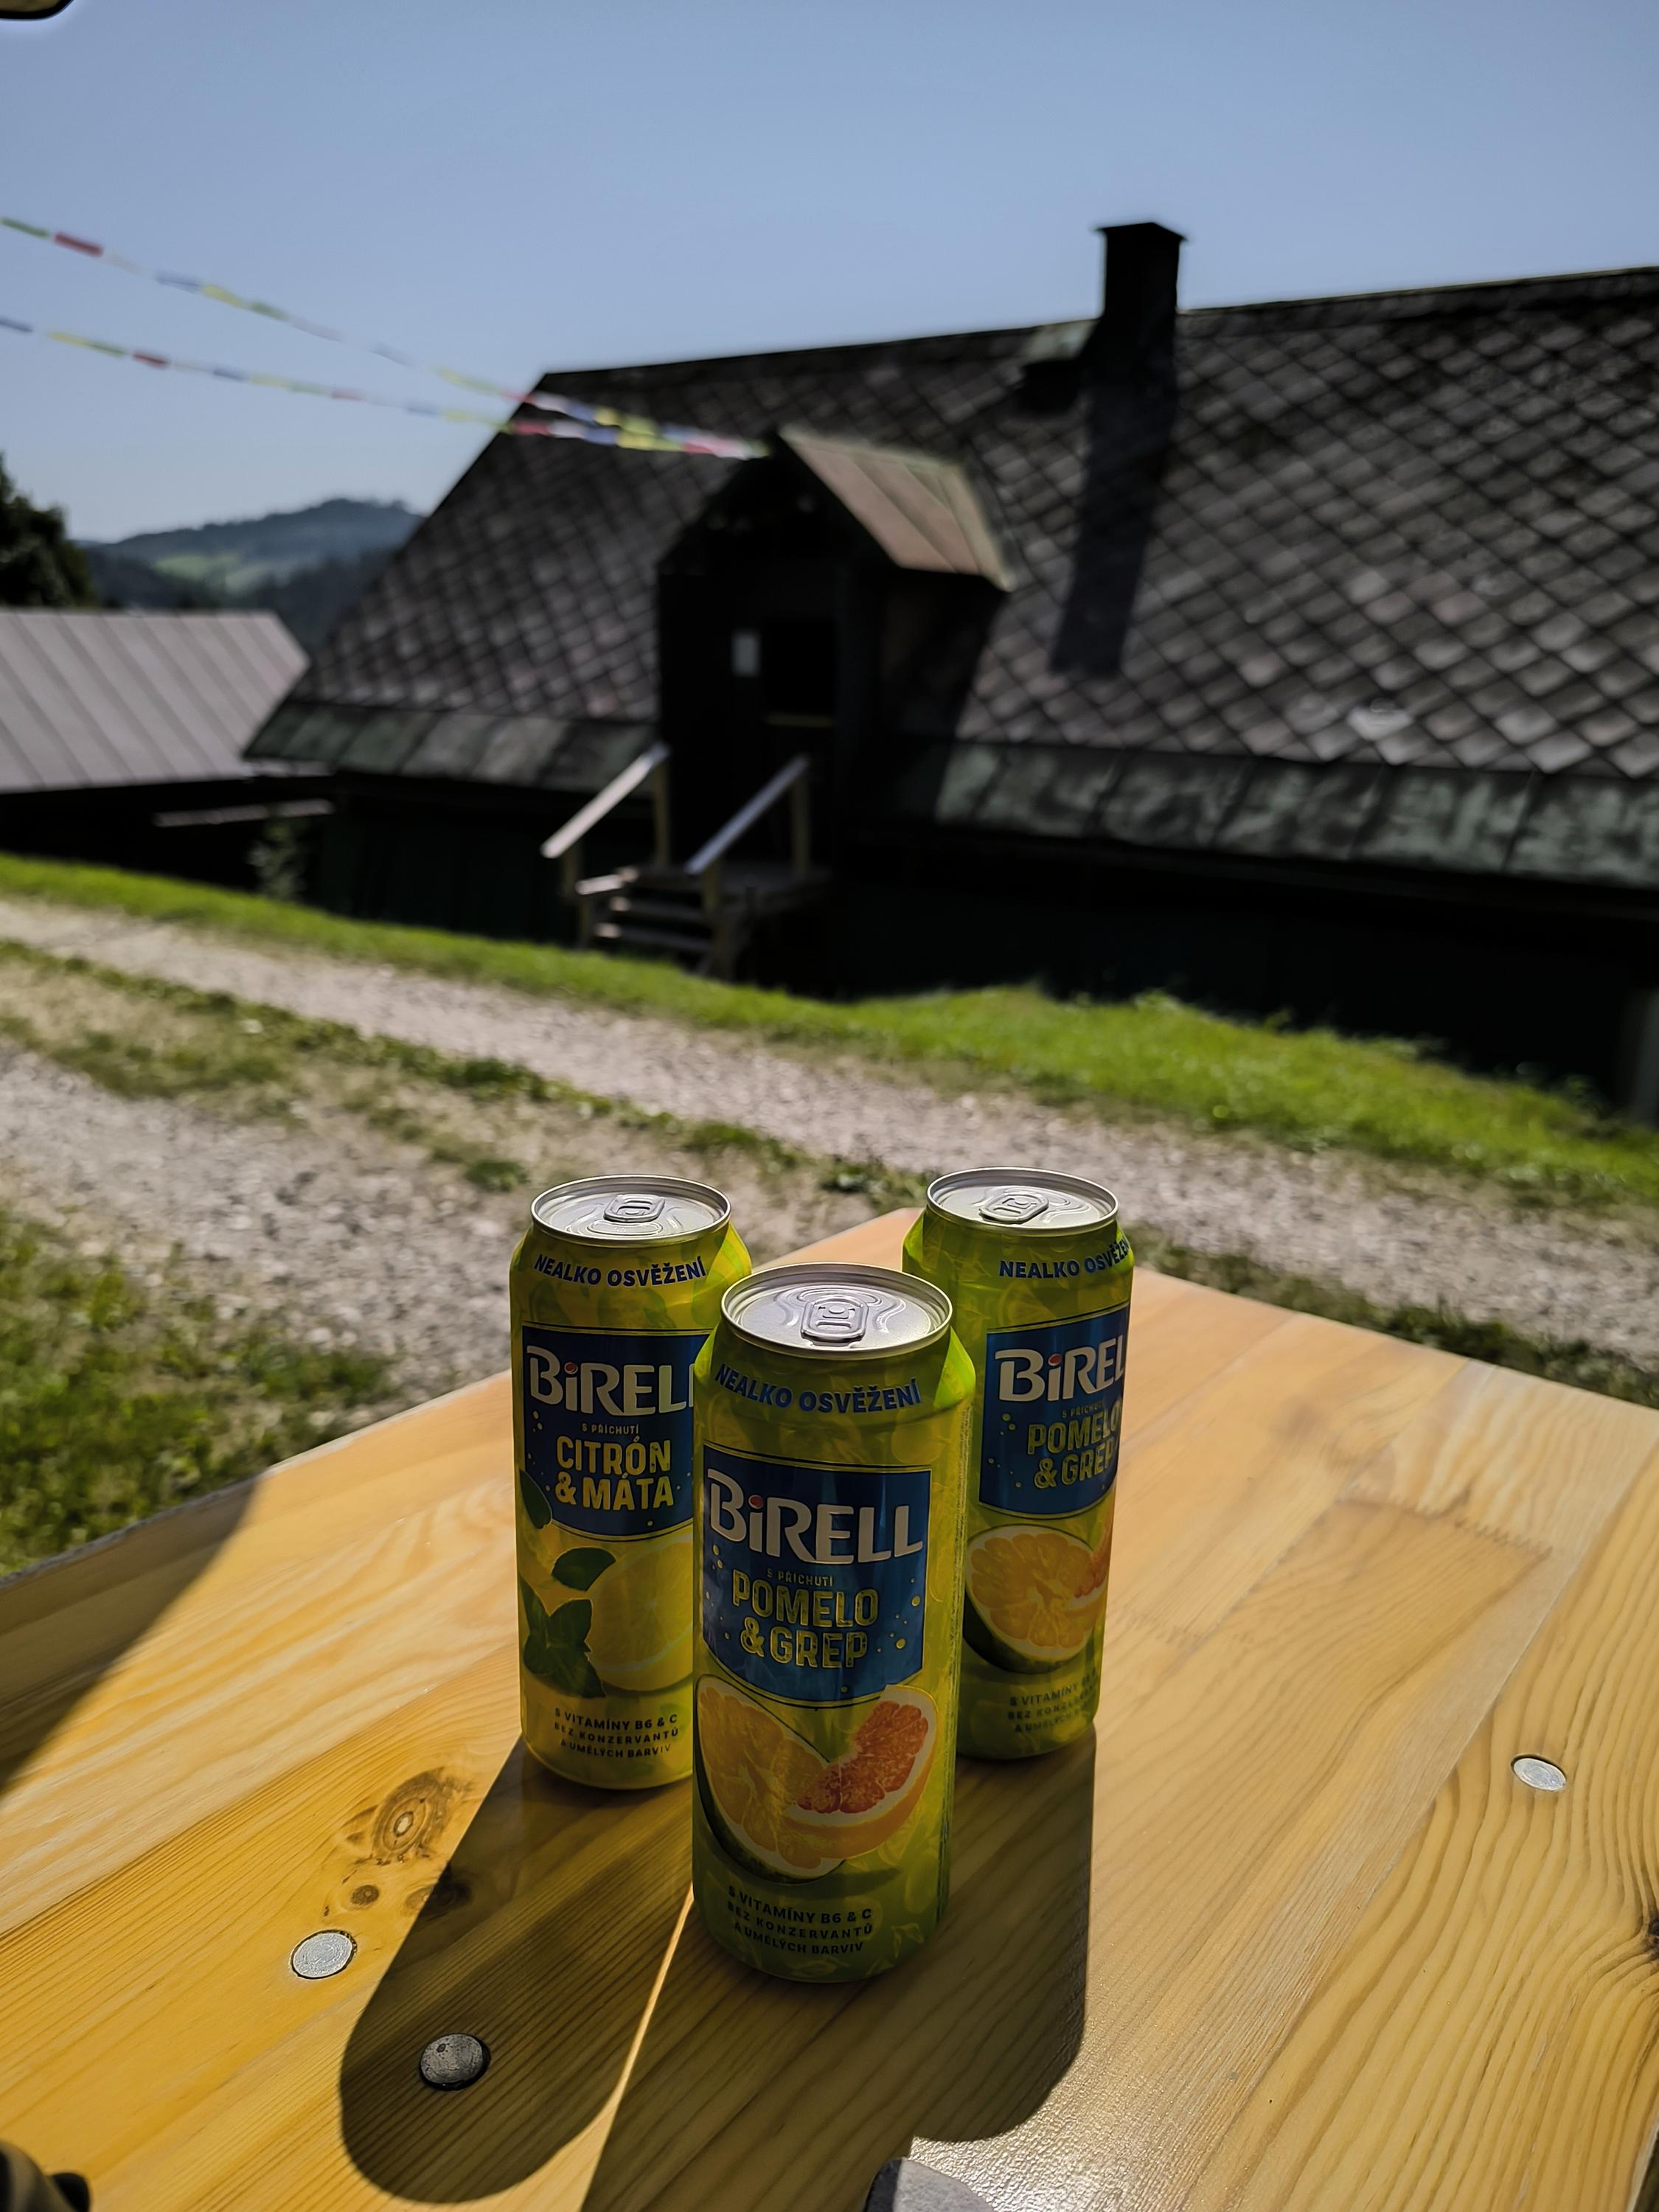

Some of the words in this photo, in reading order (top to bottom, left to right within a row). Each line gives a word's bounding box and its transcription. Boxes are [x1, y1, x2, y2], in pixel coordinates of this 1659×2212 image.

[534, 1254, 601, 1286] NEALKO
[607, 1256, 706, 1287] OSVĚŽENÍ
[999, 1259, 1080, 1279] NEALKO
[526, 1346, 695, 1416] BiREL
[714, 1363, 793, 1409] NEALKO
[799, 1377, 922, 1413] OSVĚŽENÍ
[582, 1422, 588, 1433] S
[1027, 1398, 1121, 1455] POMELO
[556, 1436, 672, 1475] CITRÓN
[766, 1568, 773, 1578] S
[732, 1569, 878, 1628] POMELO
[554, 1722, 574, 1736] BEZ
[565, 1711, 630, 1730] VITAMÍNY
[636, 1719, 652, 1730] B6
[657, 1717, 665, 1726] &
[669, 1714, 678, 1723] C
[627, 1744, 671, 1759] BARVIV
[728, 1885, 736, 1898] S
[739, 1891, 815, 1924] VITAMÍNY
[821, 1913, 841, 1924] B6
[847, 1911, 856, 1921] &
[862, 1908, 872, 1919] C
[728, 1901, 750, 1921] BEZ
[811, 1941, 863, 1955] BARVIV
